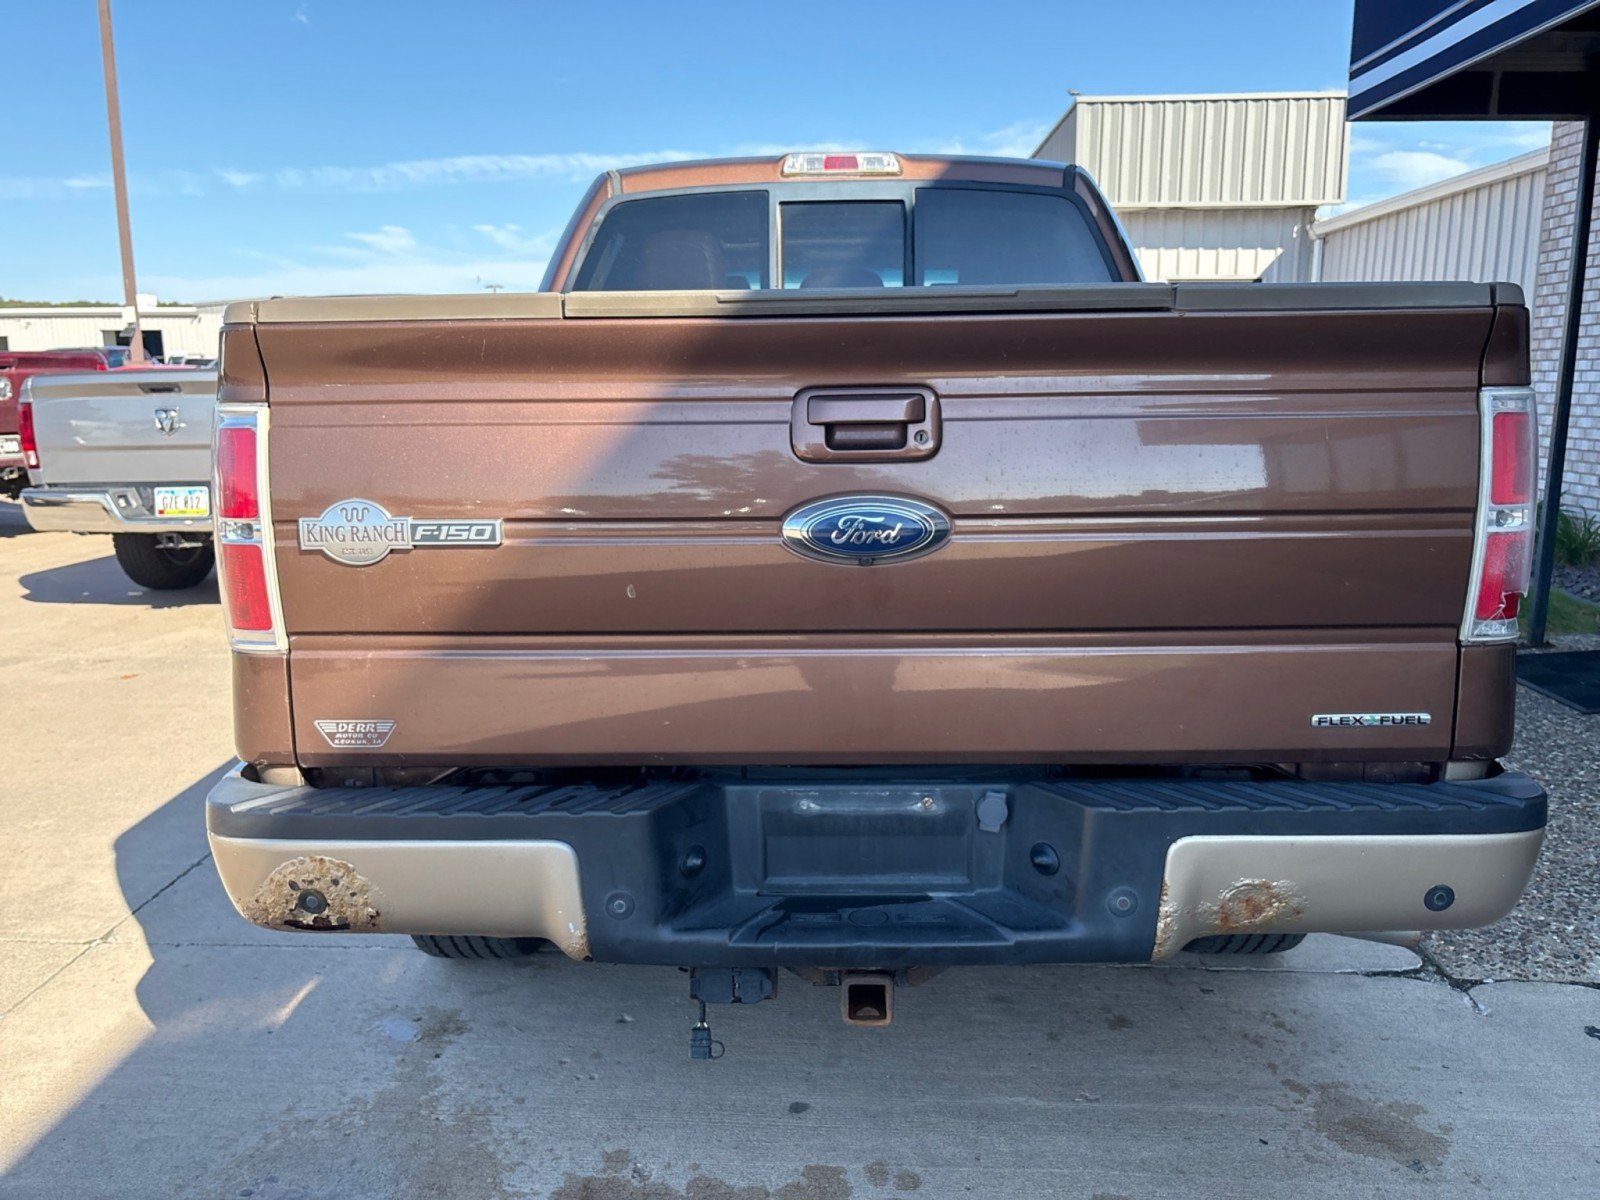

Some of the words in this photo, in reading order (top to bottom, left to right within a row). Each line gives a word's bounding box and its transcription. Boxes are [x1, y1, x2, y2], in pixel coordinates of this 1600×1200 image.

[306, 523, 346, 543] KING
[350, 523, 406, 543] RANCH
[414, 525, 492, 541] F-150
[831, 515, 903, 545] Ford
[338, 723, 375, 733] DERR
[1317, 716, 1365, 726] FLEX
[1380, 715, 1428, 725] FUEL
